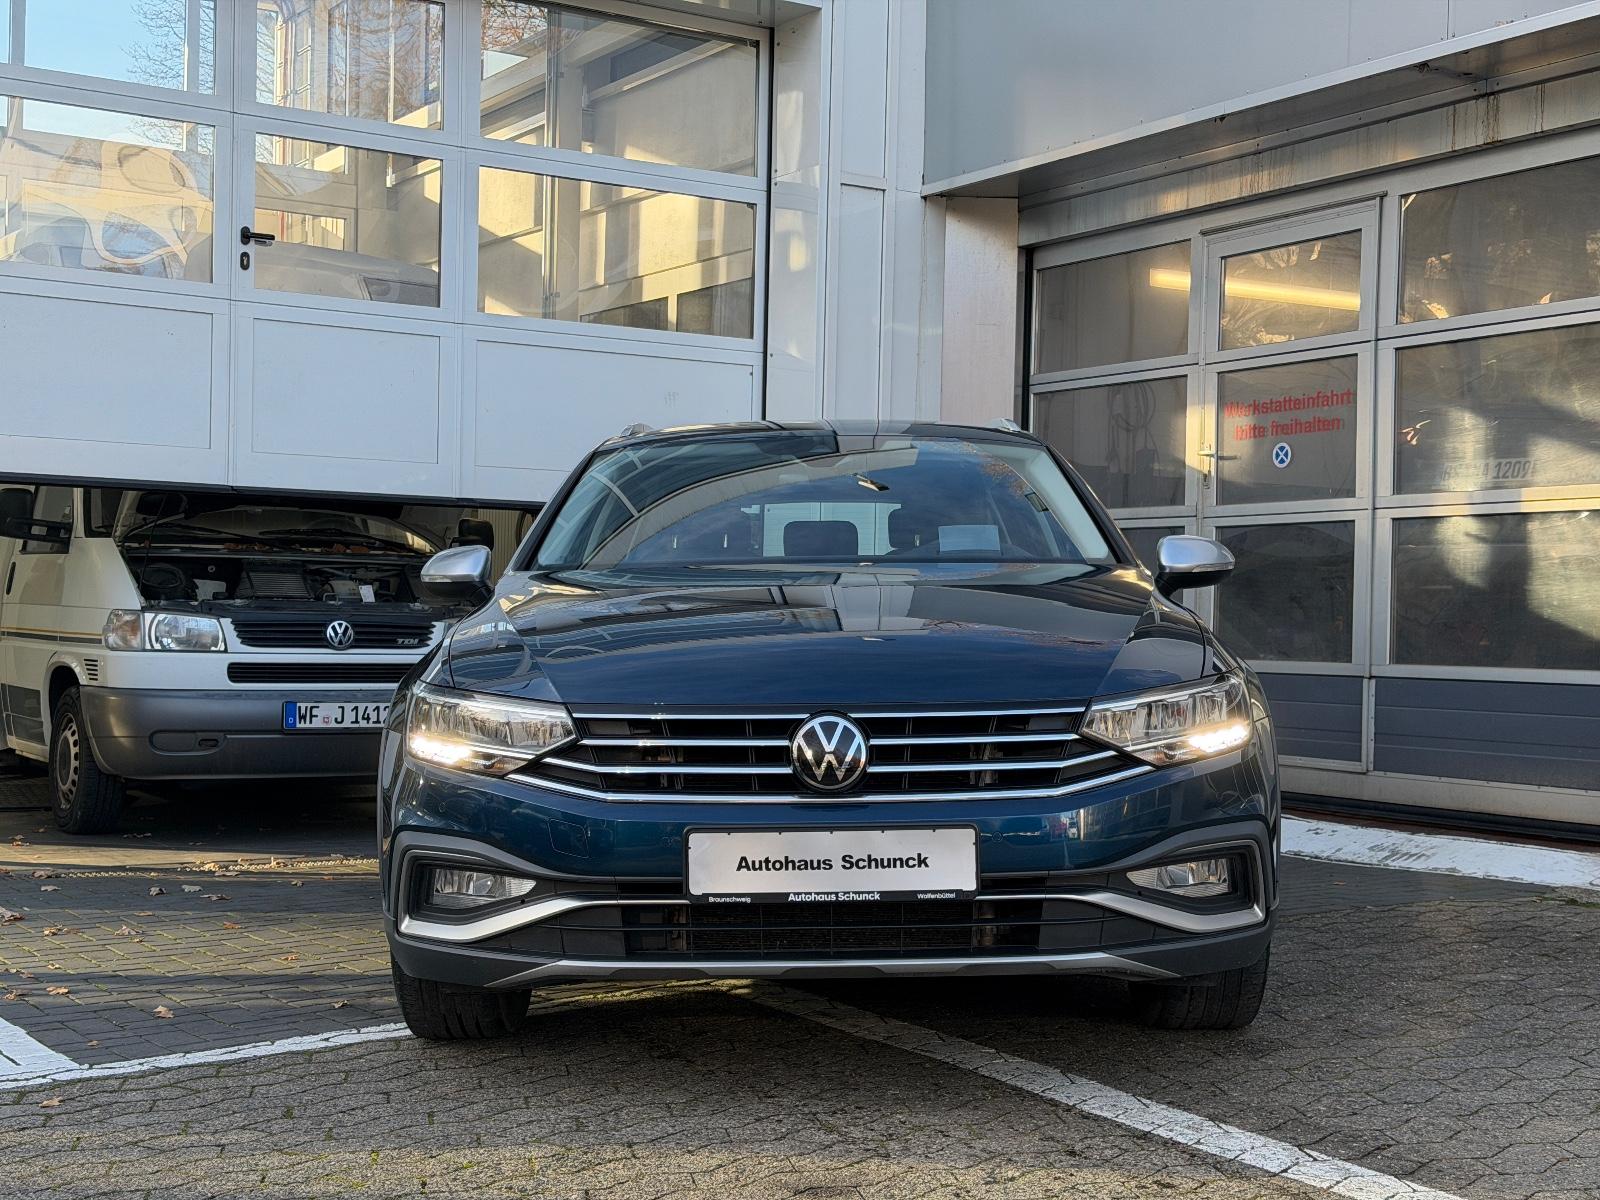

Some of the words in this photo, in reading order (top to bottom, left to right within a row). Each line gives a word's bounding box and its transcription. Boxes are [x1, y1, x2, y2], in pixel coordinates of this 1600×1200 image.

[1224, 389, 1353, 418] Werkstatteinfahrt
[1269, 415, 1343, 437] freihalten
[298, 705, 320, 725] WF
[334, 705, 346, 725] J
[736, 856, 833, 872] Autohaus
[841, 853, 929, 870] Schunck
[708, 896, 752, 904] Braunschweig
[788, 892, 836, 902] Autohaus
[838, 891, 880, 901] Schunck
